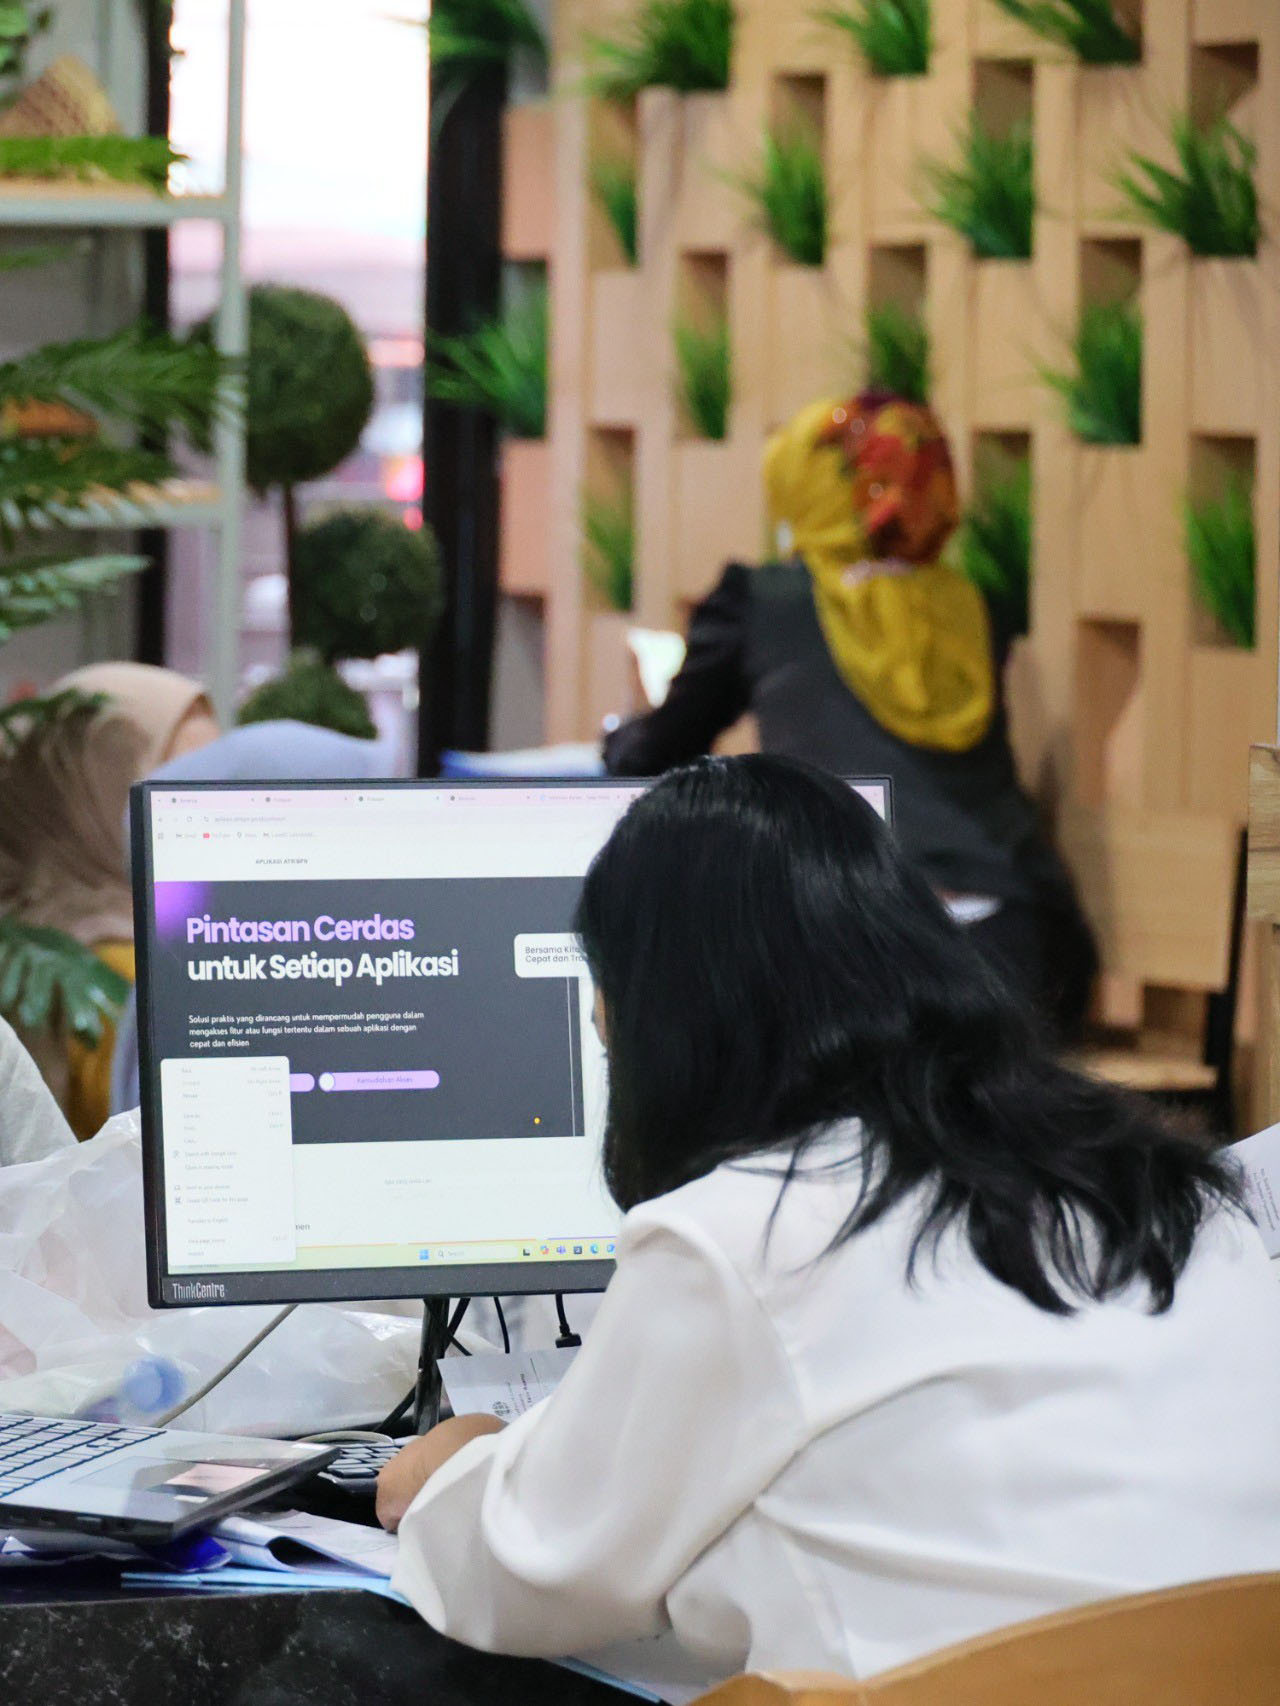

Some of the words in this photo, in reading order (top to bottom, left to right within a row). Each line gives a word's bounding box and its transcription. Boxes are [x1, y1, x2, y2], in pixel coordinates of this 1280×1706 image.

[186, 915, 311, 944] Pintasan
[313, 914, 415, 942] Cerdas
[525, 946, 563, 954] Bersama
[525, 955, 551, 965] Cepat
[188, 953, 267, 982] untuk
[269, 951, 353, 986] Setiap
[355, 949, 459, 985] Aplikasi
[188, 1014, 210, 1024] Solusi
[211, 1014, 235, 1025] praktis
[236, 1015, 254, 1025] yang
[255, 1013, 291, 1024] dirancang
[292, 1013, 311, 1021] untuk
[312, 1012, 365, 1022] mempermudah
[366, 1012, 401, 1022] pengguna
[402, 1011, 424, 1020] dalam
[189, 1028, 228, 1037] mengakses
[245, 1027, 261, 1035] atau
[261, 1026, 283, 1036] fungsi
[284, 1025, 313, 1034] tertentu
[313, 1025, 336, 1033] dalam
[336, 1024, 362, 1033] sebuah
[363, 1024, 389, 1034] aplikasi
[390, 1023, 417, 1034] dengan
[190, 1039, 211, 1049] cepat
[212, 1039, 226, 1047] dan
[227, 1038, 250, 1047] efisien
[172, 1281, 225, 1299] ThinkCentre
